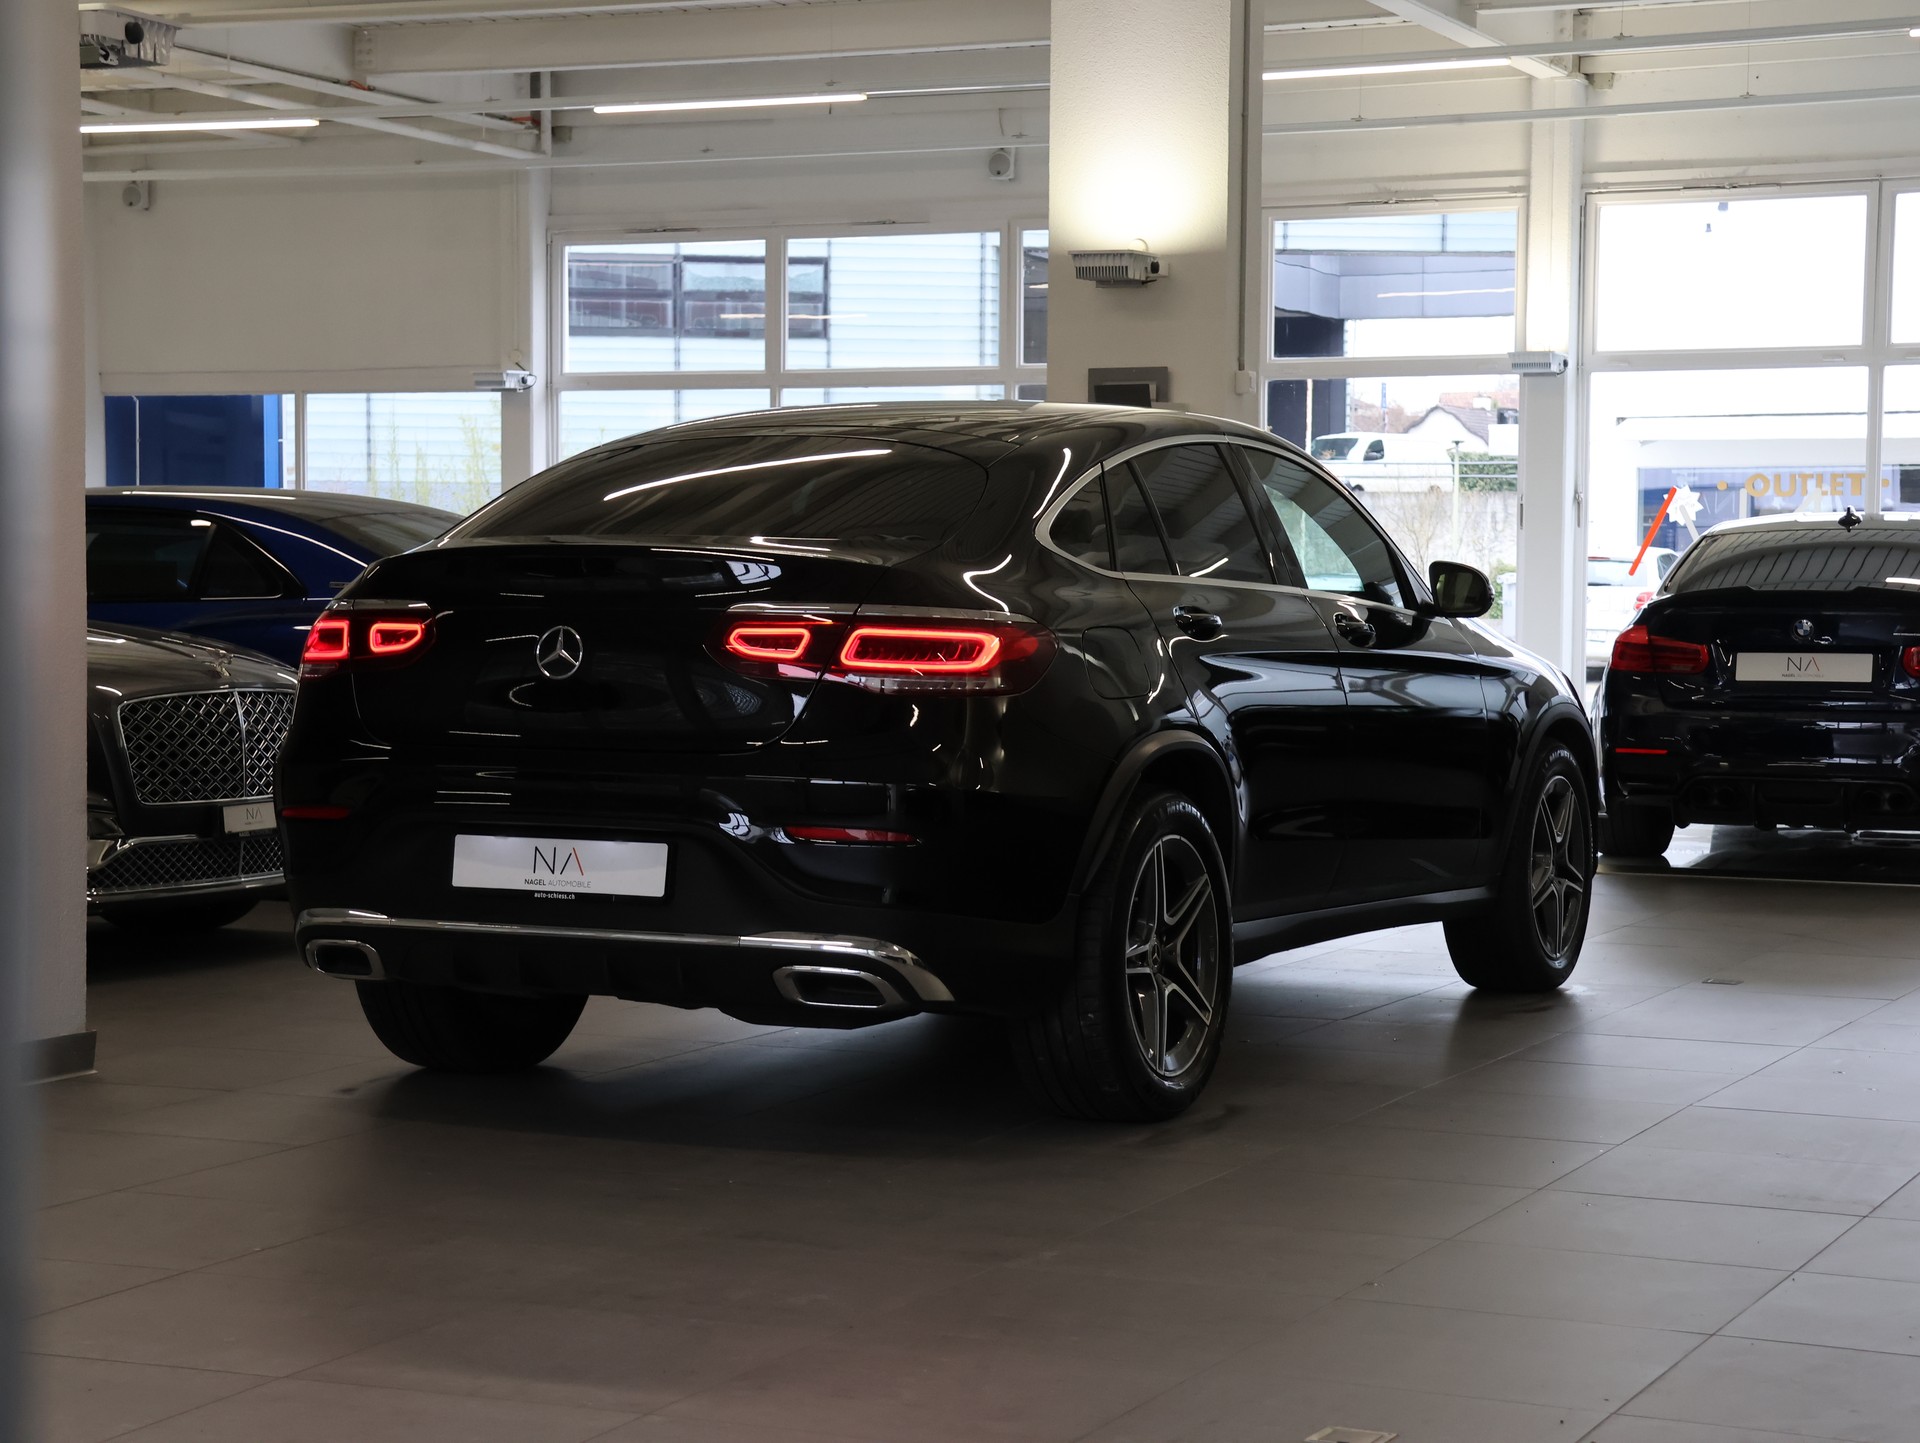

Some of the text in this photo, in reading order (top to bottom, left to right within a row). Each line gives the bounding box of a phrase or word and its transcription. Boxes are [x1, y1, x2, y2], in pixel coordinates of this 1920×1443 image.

[1744, 472, 1867, 497] OUTLET
[533, 846, 585, 876] NA
[548, 879, 592, 888] AUTOMOBILE
[534, 892, 575, 900] auto-schiess.ch
